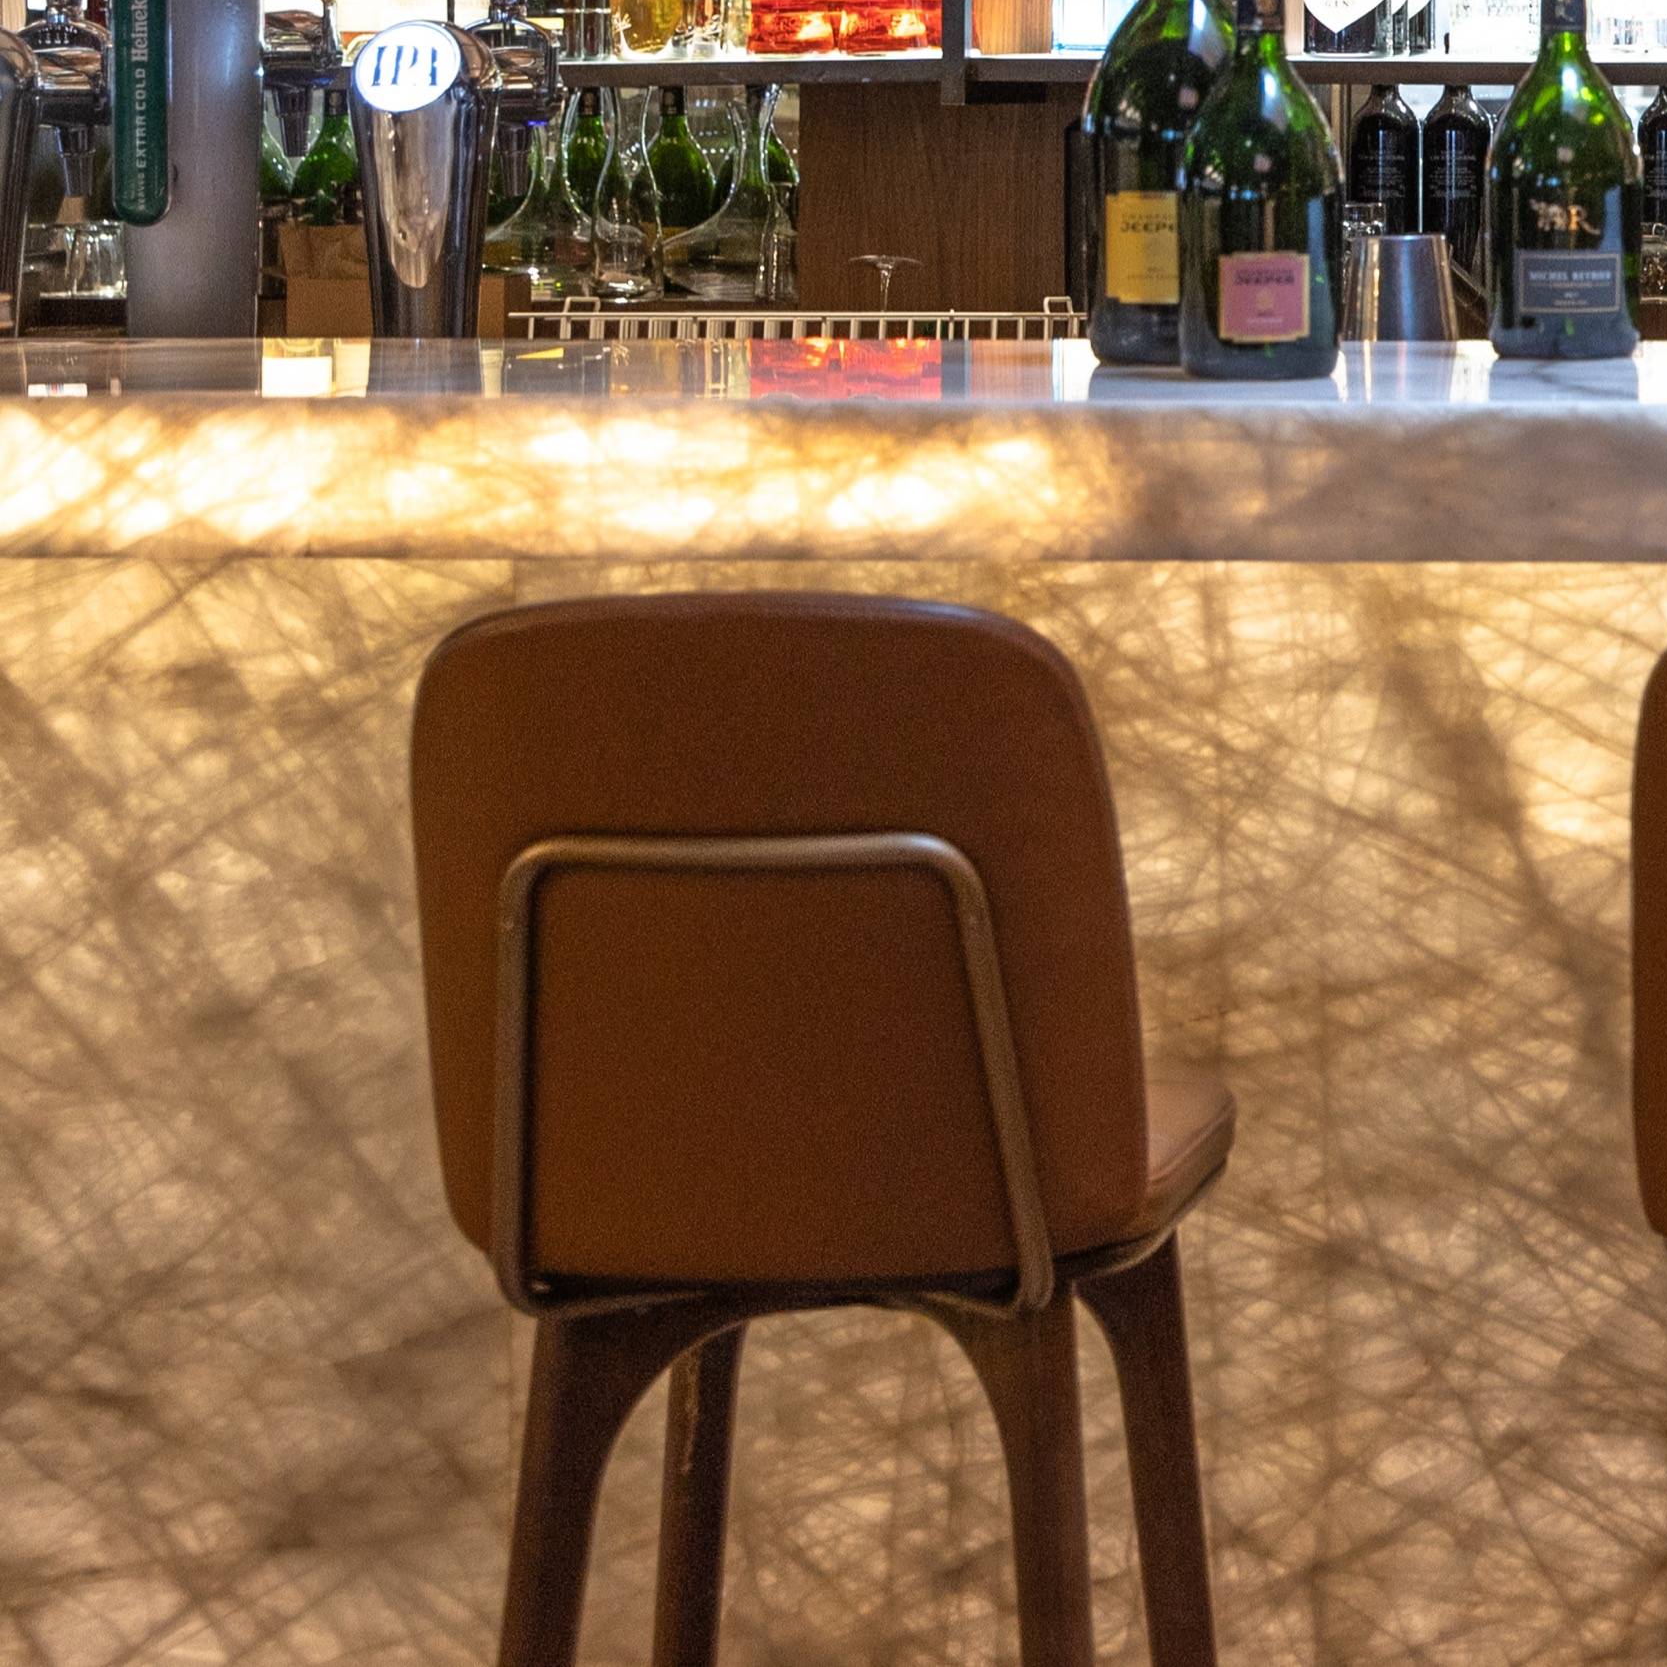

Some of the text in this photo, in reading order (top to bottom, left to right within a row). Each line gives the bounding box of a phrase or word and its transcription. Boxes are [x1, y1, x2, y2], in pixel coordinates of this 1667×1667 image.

[135, 67, 147, 112] COLD
[135, 113, 148, 169] EXTRA
[1119, 219, 1179, 234] JEEPE
